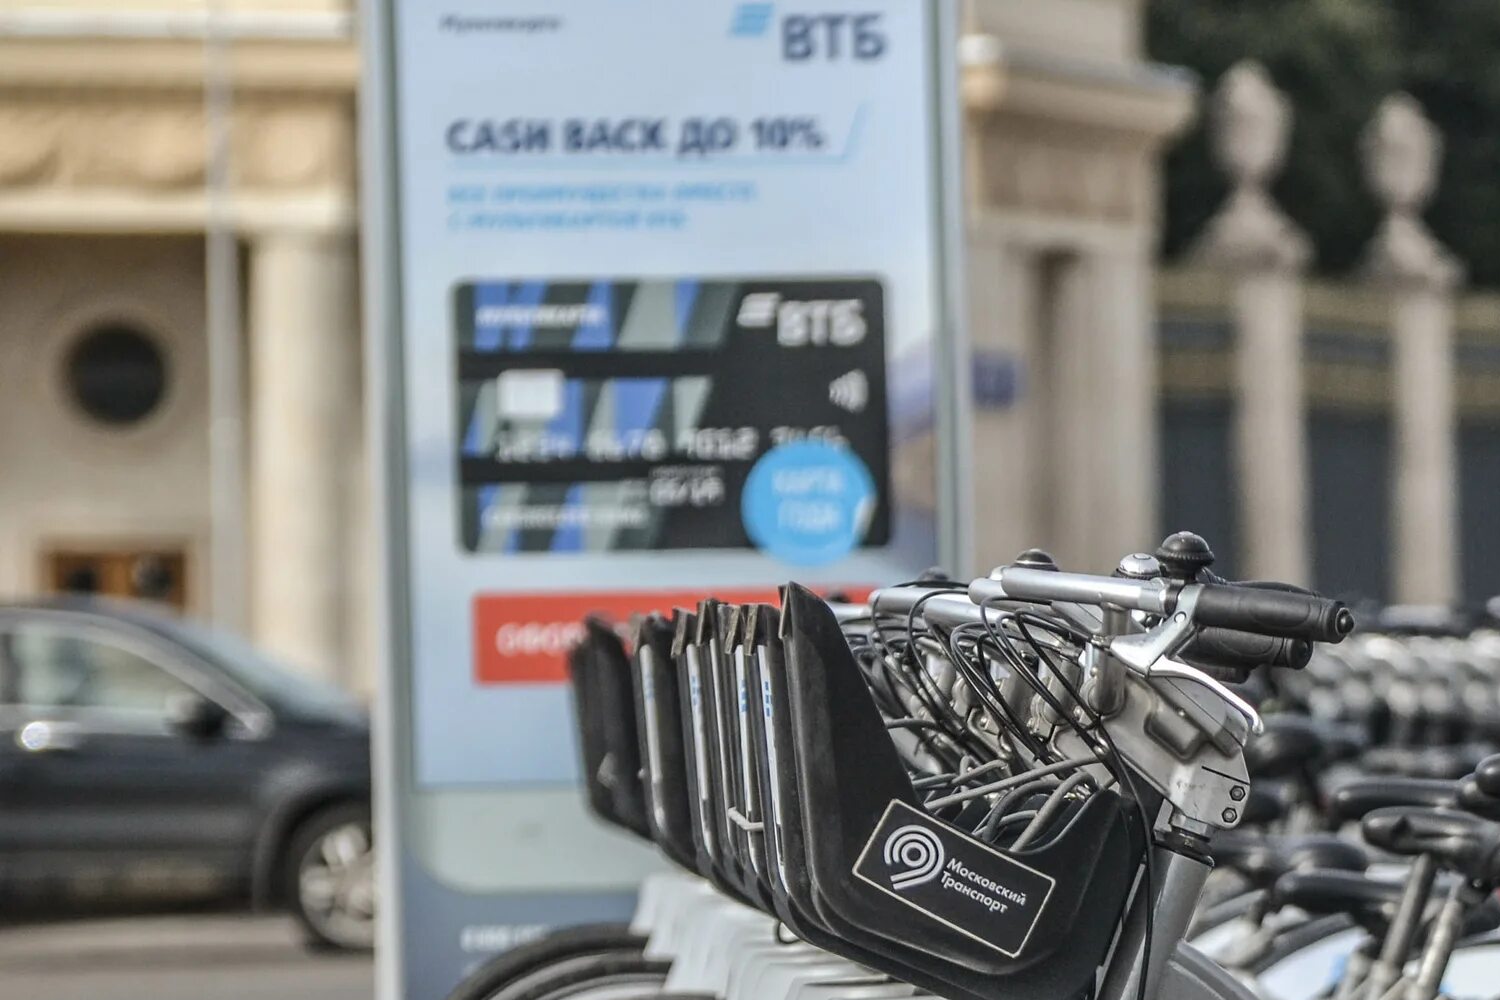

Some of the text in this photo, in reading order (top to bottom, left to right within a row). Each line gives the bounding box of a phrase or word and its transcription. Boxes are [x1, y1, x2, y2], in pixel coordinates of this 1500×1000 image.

[781, 14, 887, 62] ВТБ
[563, 118, 666, 153] BACK
[677, 120, 738, 159] ДО
[752, 119, 828, 152] 10%
[777, 298, 867, 348] ВТБ
[940, 870, 1009, 914] Транспорт
[945, 857, 1028, 907] Московский
